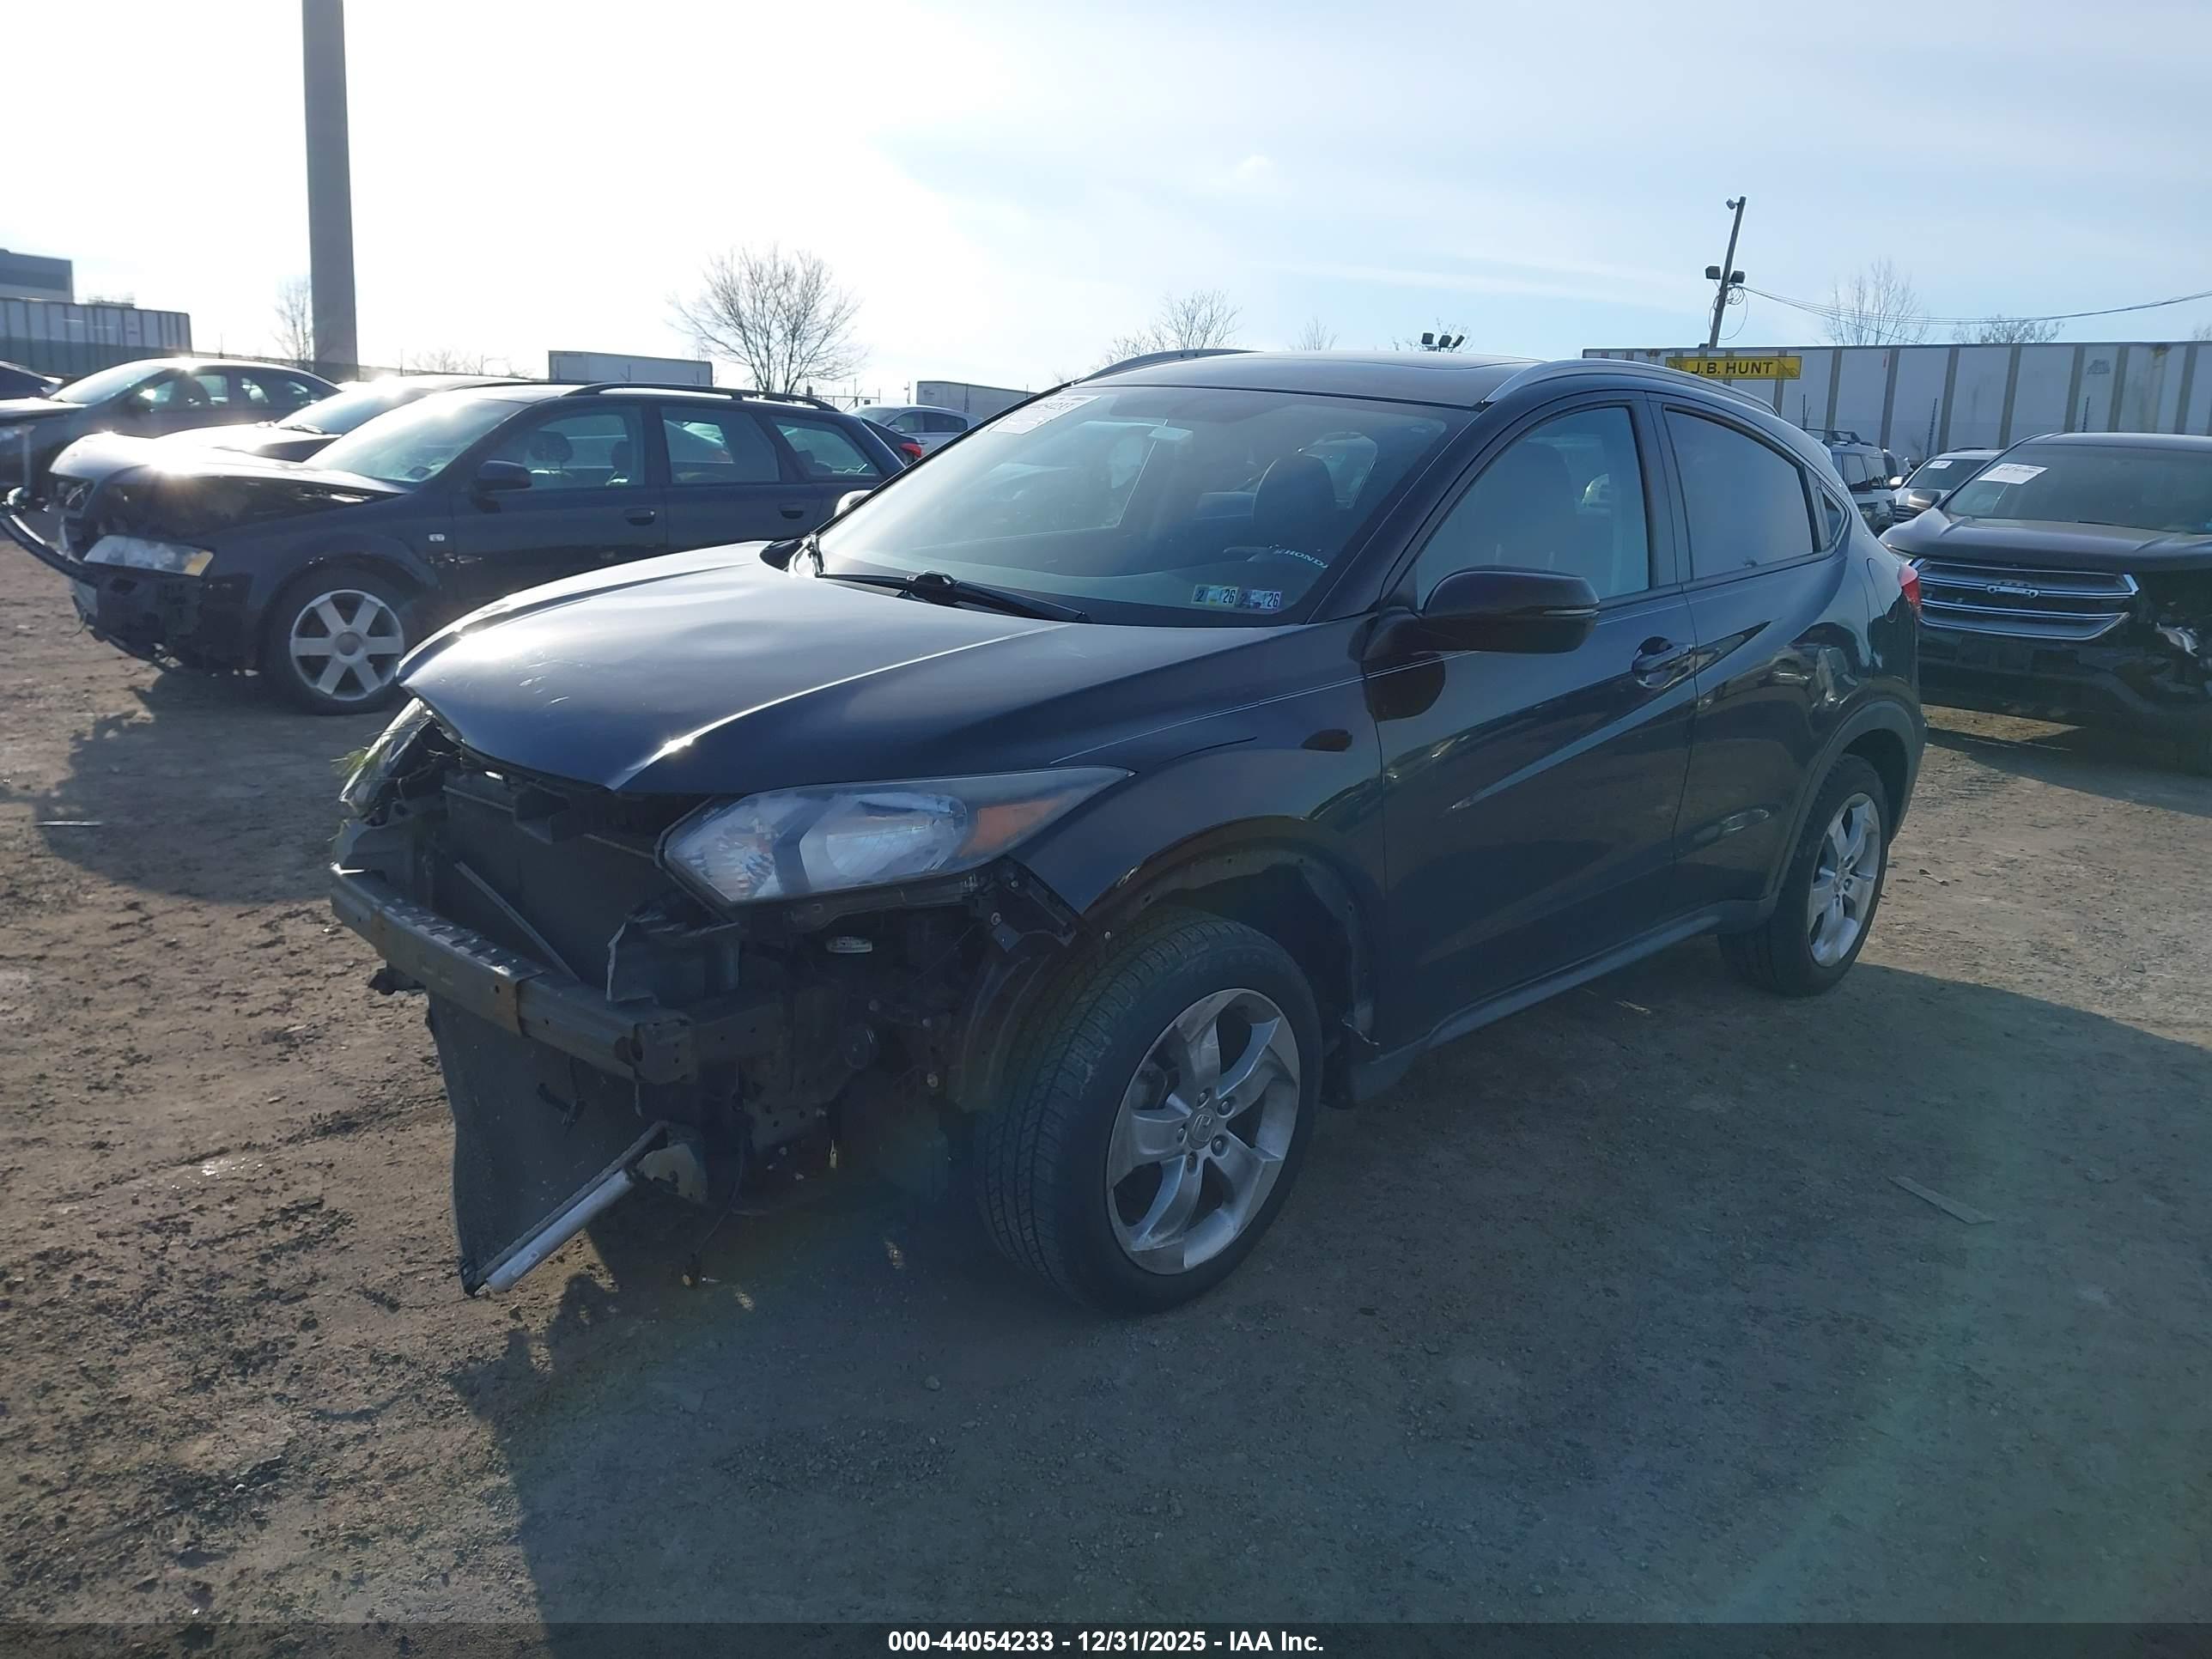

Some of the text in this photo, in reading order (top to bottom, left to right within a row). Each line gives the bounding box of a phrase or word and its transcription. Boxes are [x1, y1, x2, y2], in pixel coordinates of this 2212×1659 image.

[1726, 362, 1773, 374] HUNT
[1223, 589, 1236, 604] 26
[1267, 592, 1279, 607] 26
